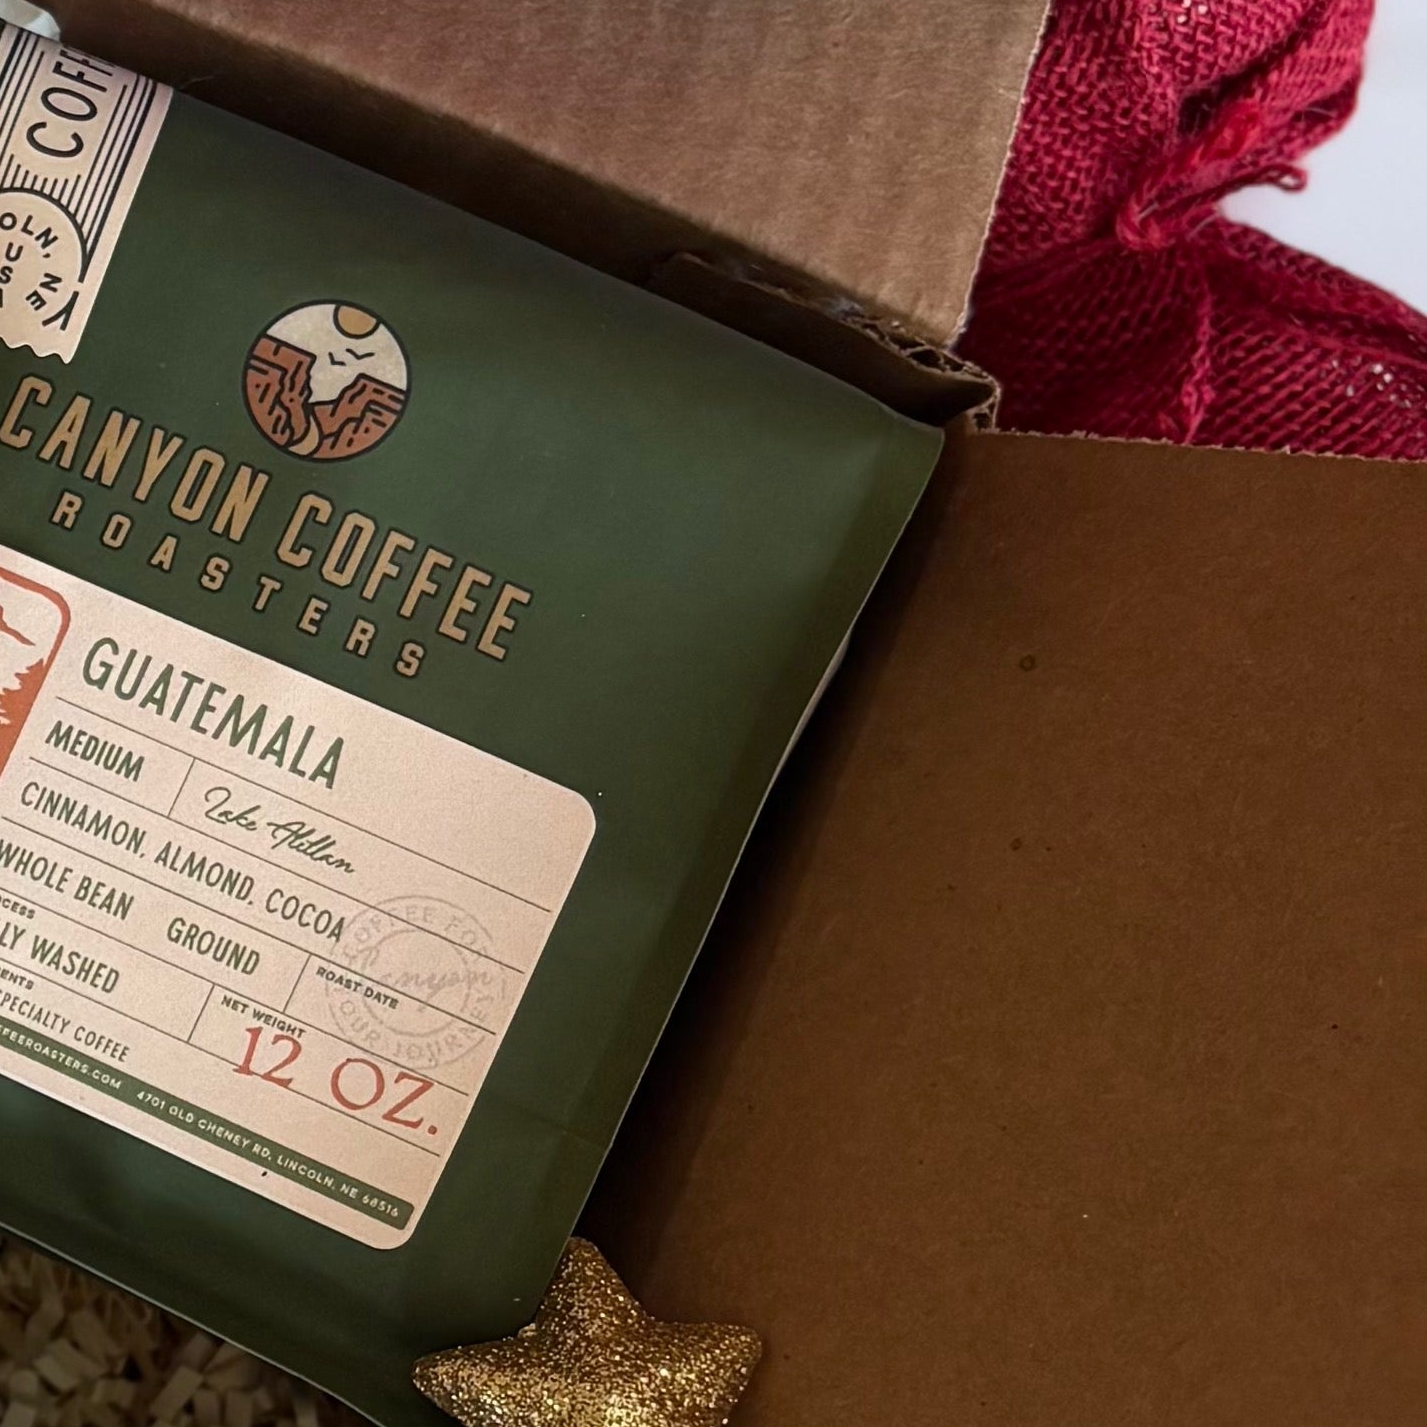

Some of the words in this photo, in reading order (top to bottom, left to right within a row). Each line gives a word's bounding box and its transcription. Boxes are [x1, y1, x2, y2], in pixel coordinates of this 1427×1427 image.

[25, 272, 63, 311] NE
[51, 490, 425, 678] ROASTERS
[275, 492, 533, 661] COFFEE
[45, 720, 145, 782] MEDIUM
[82, 636, 346, 791] GUATEMALA
[204, 787, 261, 831] Lake
[21, 781, 147, 859] CINNAMON,
[265, 888, 346, 943] COCOA
[30, 935, 120, 994] WASHED
[74, 874, 135, 921] BEAN
[167, 916, 261, 976] GROUND
[221, 995, 249, 1014] NET
[252, 1009, 306, 1039] WEIGHT
[315, 966, 363, 993] ROAST
[364, 984, 400, 1010] DATE
[73, 1026, 131, 1063] COFFEE
[233, 1026, 302, 1088] 12
[330, 1058, 438, 1135] OZ.
[137, 1091, 166, 1111] 4701
[168, 1105, 195, 1124] OLD
[198, 1118, 250, 1150] CHENEY
[340, 1181, 359, 1199] NE
[361, 1191, 399, 1218] 68516
